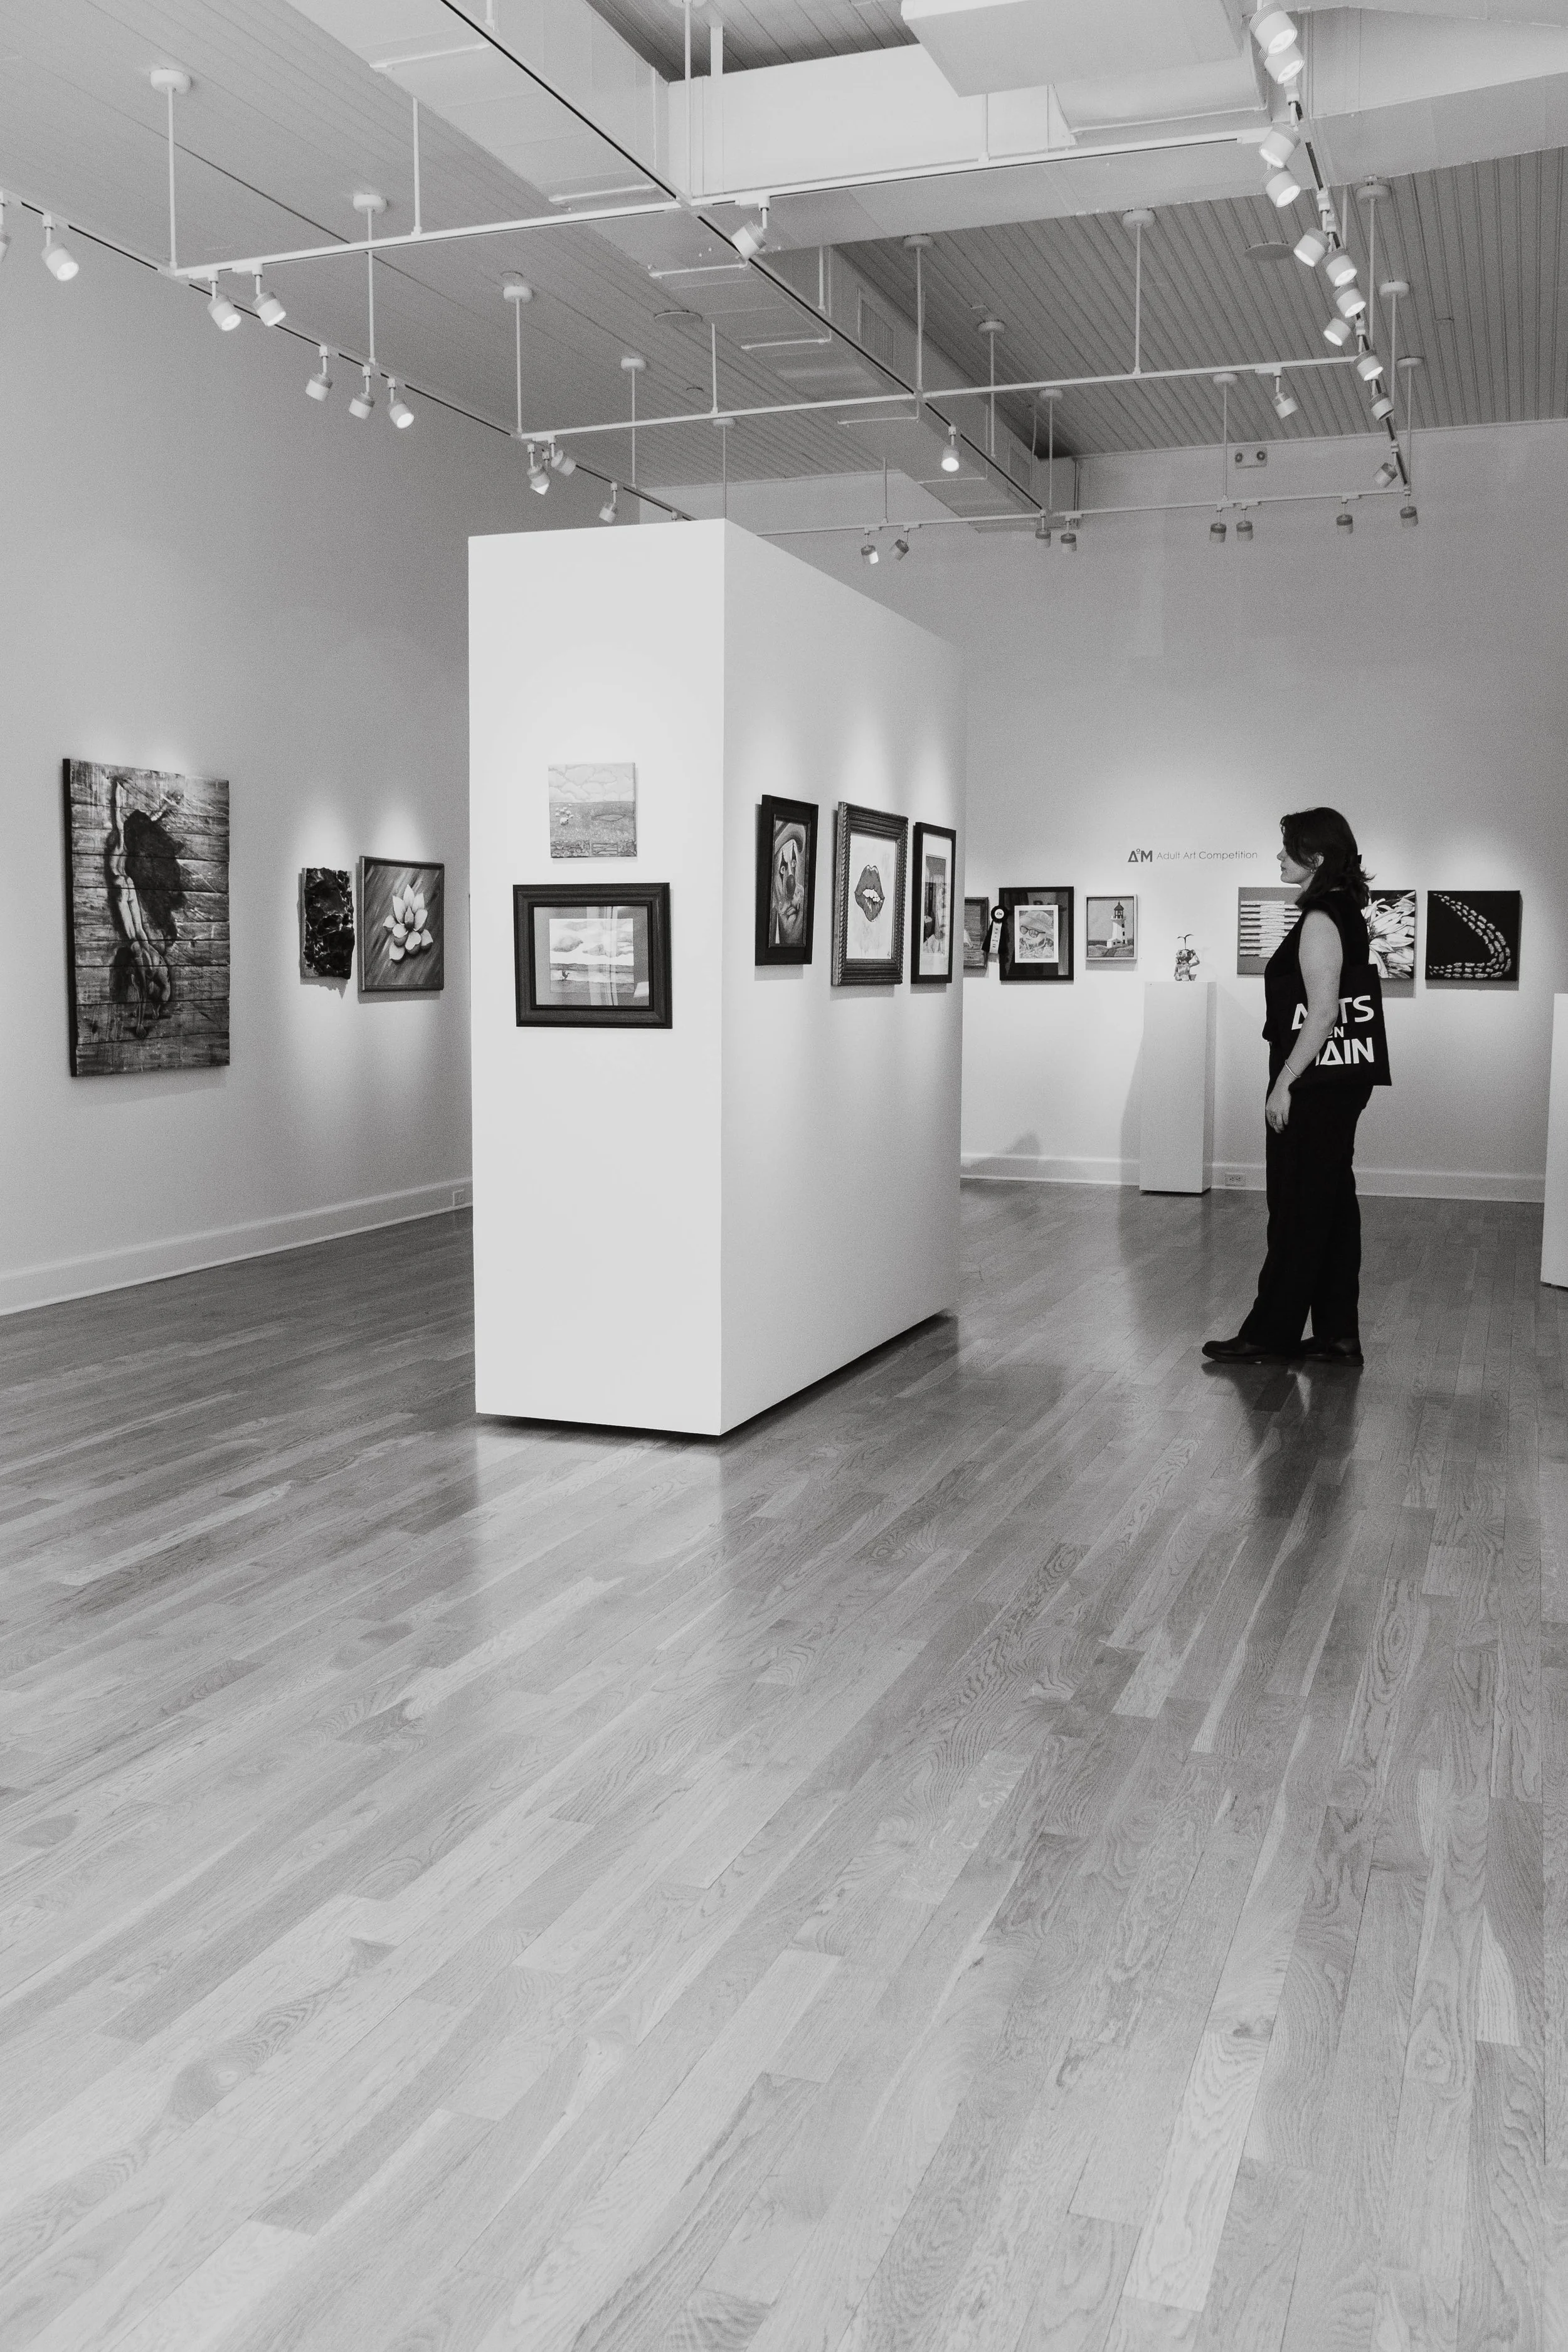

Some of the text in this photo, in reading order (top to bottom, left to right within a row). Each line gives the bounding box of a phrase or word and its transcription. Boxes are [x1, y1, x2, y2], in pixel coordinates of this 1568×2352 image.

[1157, 851, 1180, 860] Adult
[1183, 851, 1195, 860] Art
[1199, 850, 1258, 862] Competition
[1291, 995, 1374, 1030] ATS
[1315, 1037, 1374, 1066] AIN
